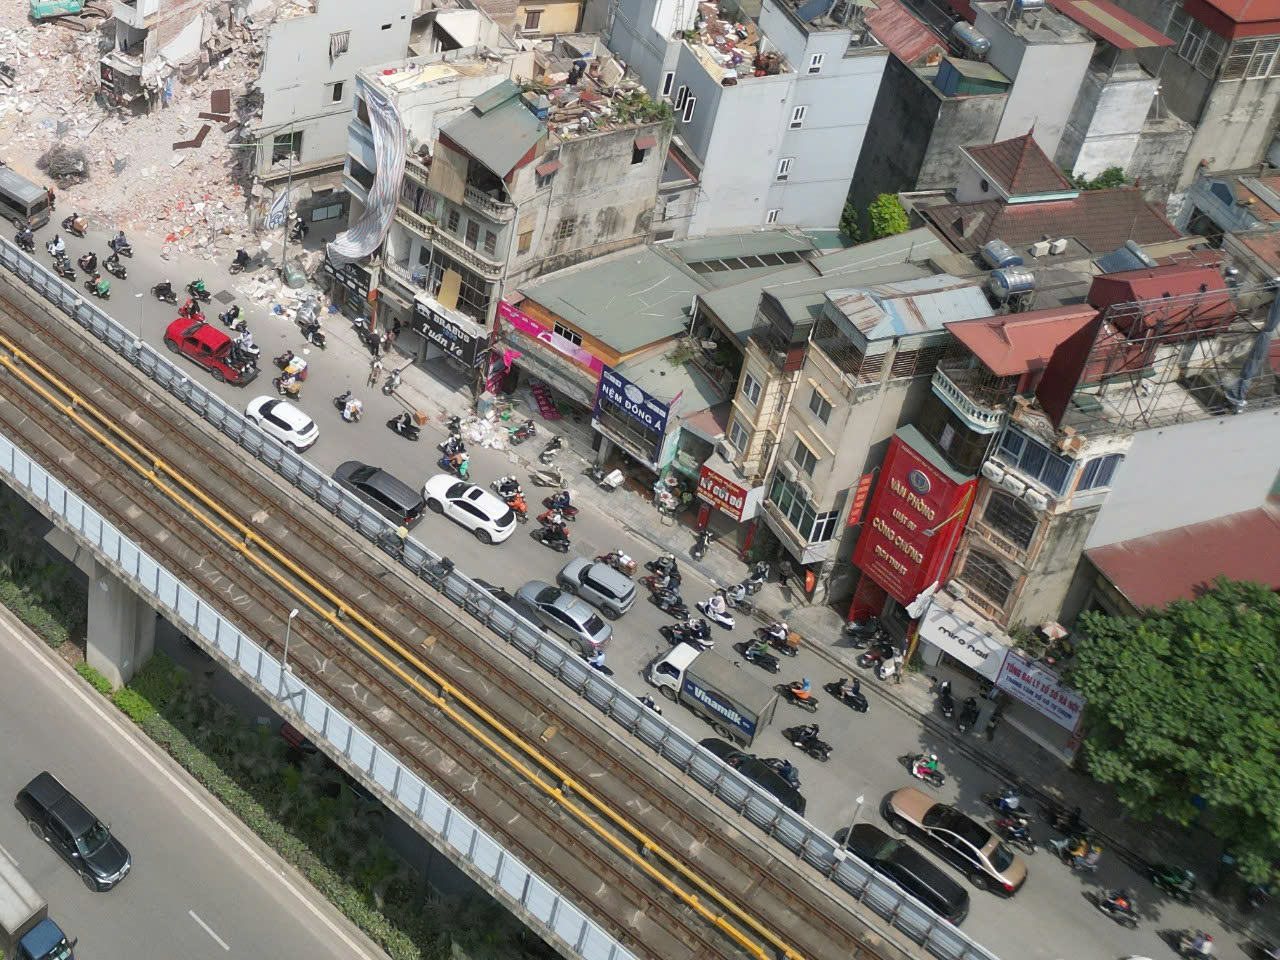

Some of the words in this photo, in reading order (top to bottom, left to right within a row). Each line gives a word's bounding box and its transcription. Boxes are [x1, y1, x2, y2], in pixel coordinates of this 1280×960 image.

[433, 313, 470, 343] BRABUS
[602, 384, 623, 404] NỆM
[624, 400, 652, 425] ĐÔNG
[907, 491, 935, 521] PHÒNG
[872, 517, 895, 541] CÔNG
[895, 535, 923, 564] CHỨNG
[938, 626, 966, 645] miro
[967, 644, 989, 660] nail
[694, 686, 741, 726] Vinamilk
